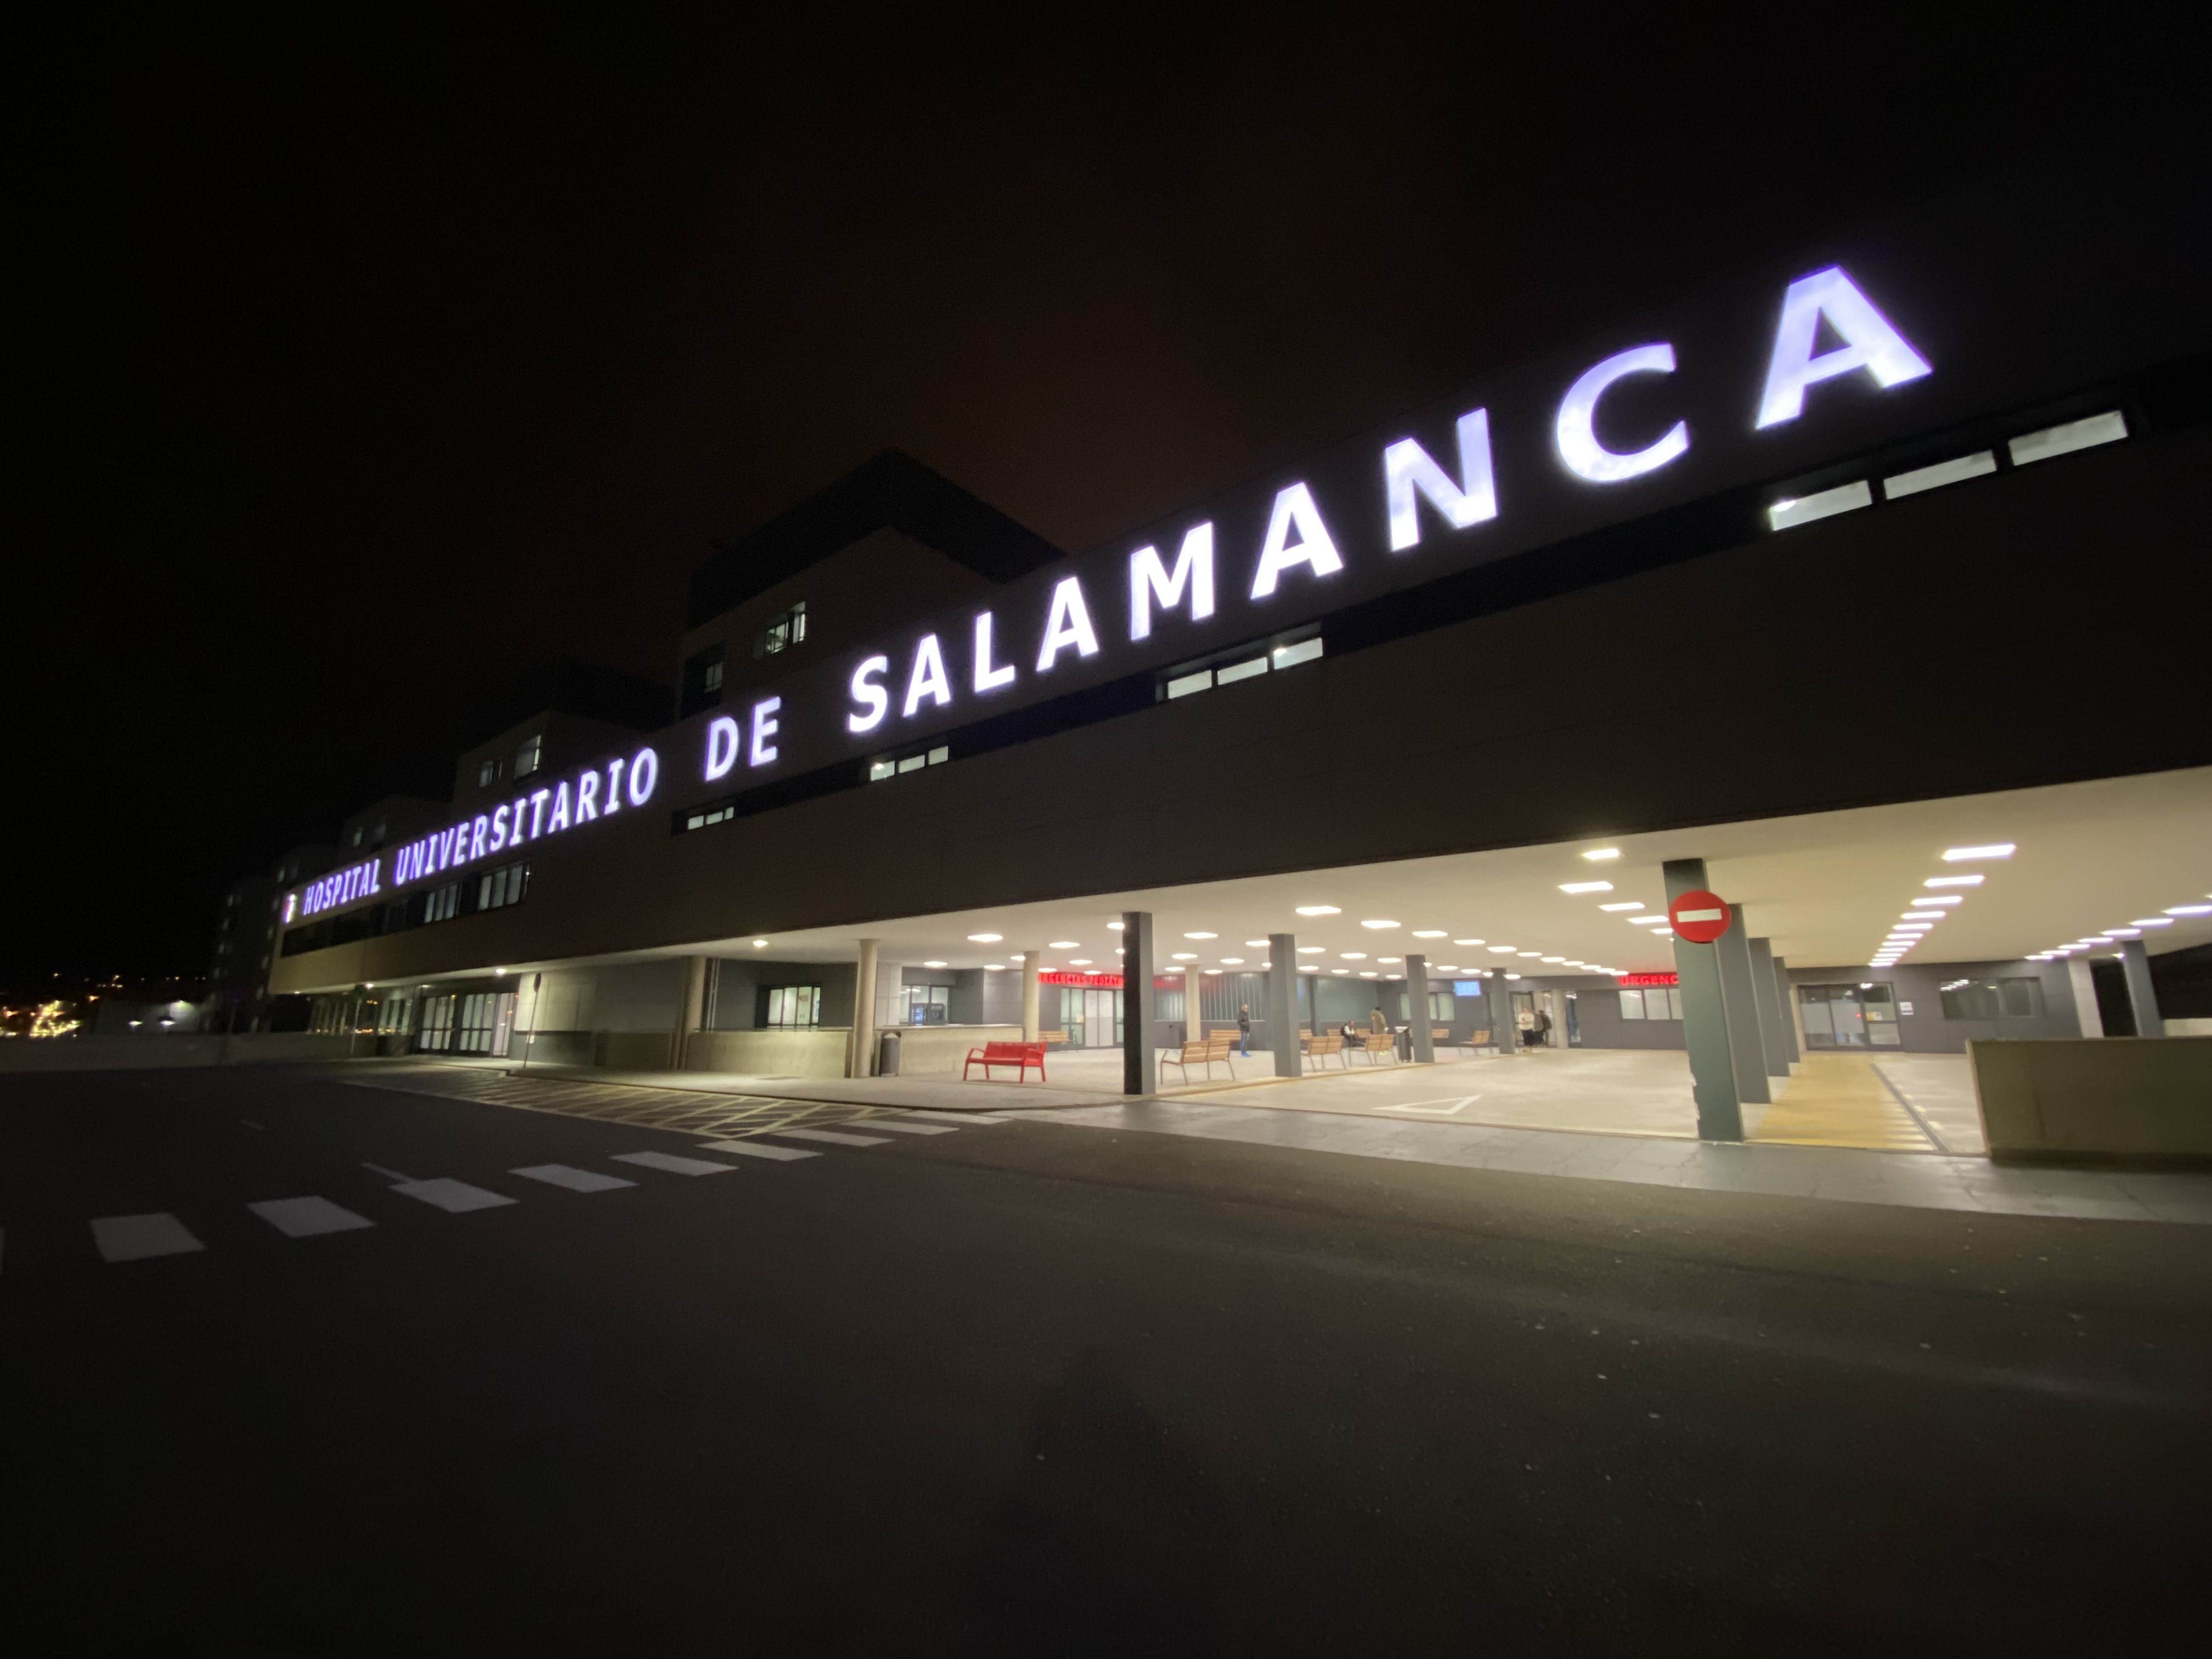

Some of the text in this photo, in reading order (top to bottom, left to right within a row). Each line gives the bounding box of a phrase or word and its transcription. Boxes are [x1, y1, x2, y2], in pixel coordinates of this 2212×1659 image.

[302, 263, 1934, 916] HOSPITAL UNIVERSITARIO DE SALAMANCA
